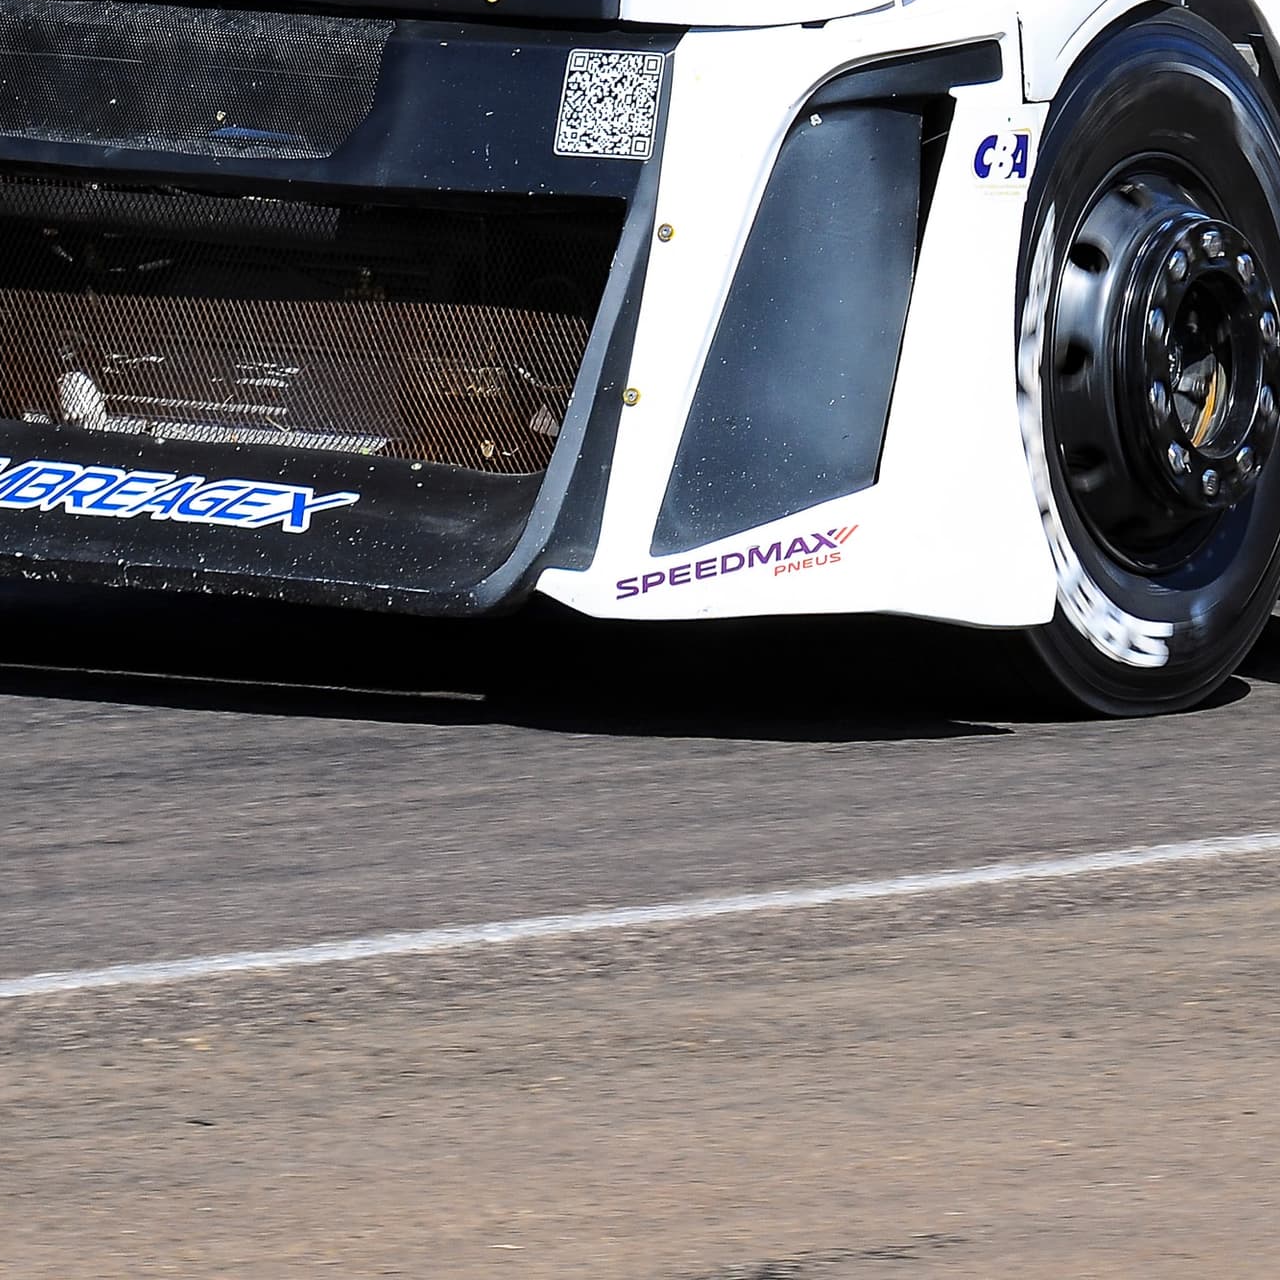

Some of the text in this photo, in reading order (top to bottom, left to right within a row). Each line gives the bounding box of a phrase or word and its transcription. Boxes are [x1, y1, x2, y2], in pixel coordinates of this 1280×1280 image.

[973, 134, 1029, 179] CBA
[616, 528, 838, 600] SPEEDMAX
[774, 551, 842, 577] PNEUS
